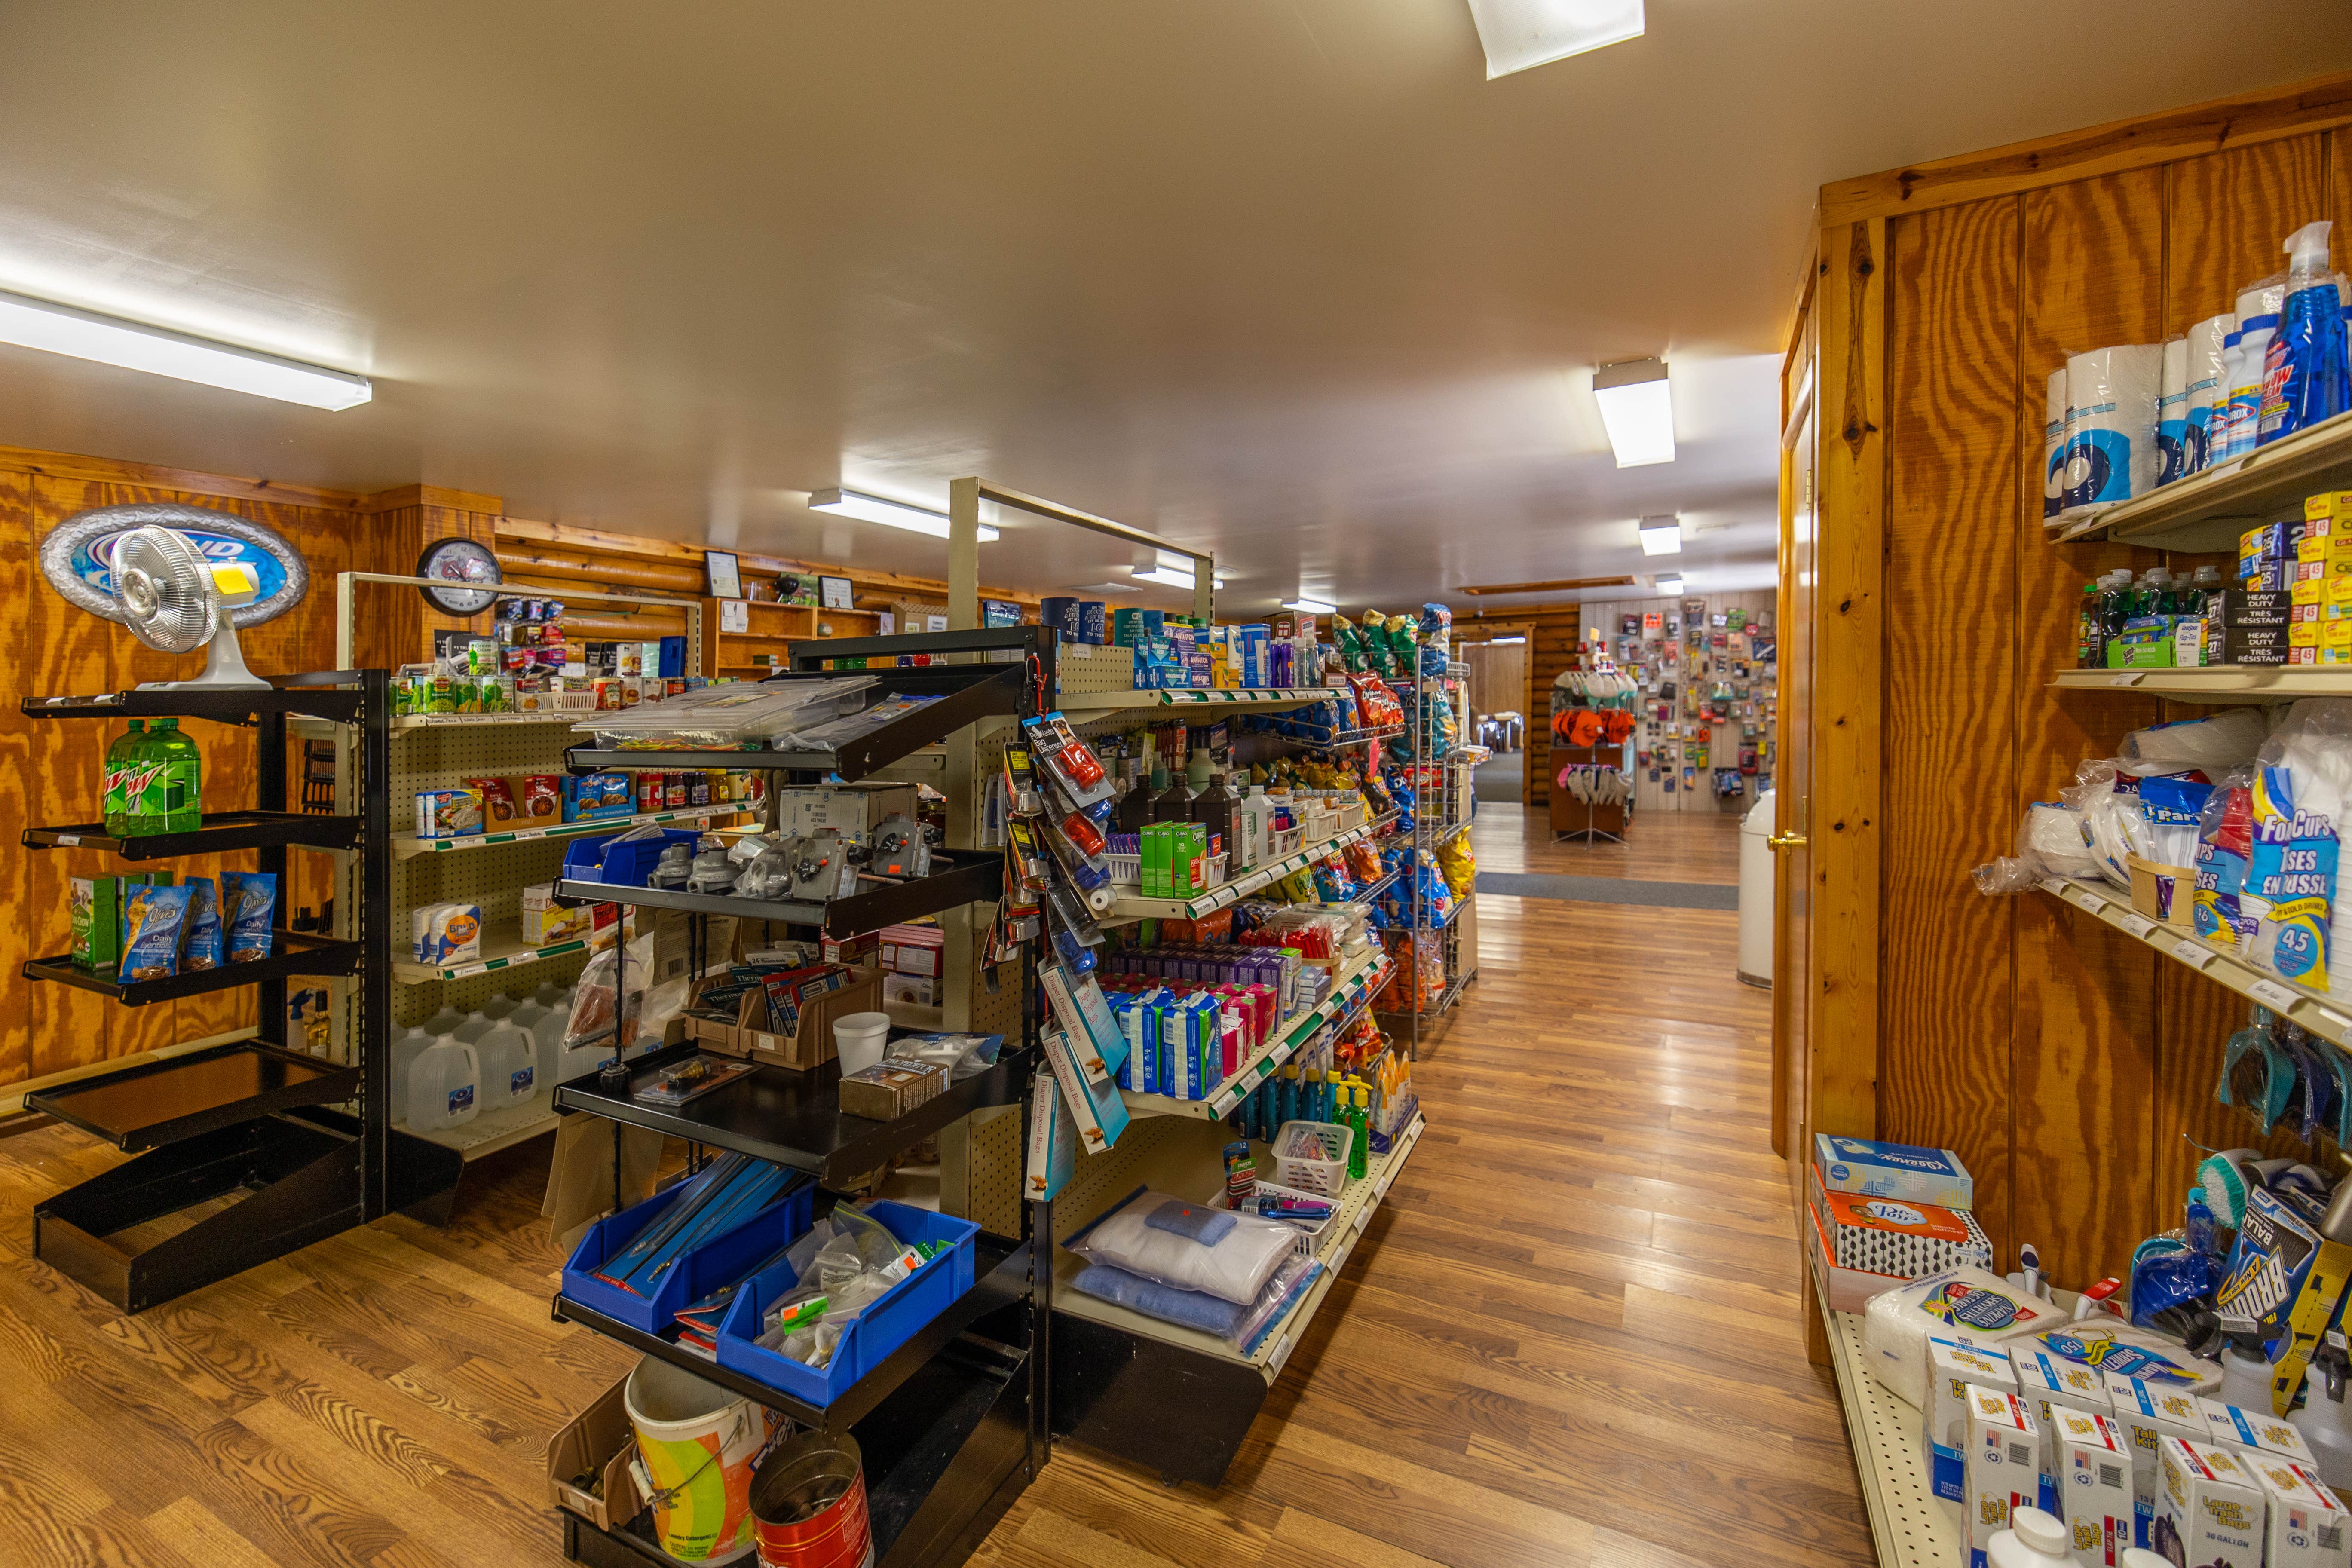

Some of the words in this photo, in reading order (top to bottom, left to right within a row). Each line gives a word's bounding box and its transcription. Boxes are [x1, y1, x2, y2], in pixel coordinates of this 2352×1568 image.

[2318, 521, 2326, 531] 45
[2311, 564, 2320, 574] 45
[2261, 572, 2272, 585] 25
[2208, 606, 2217, 618] 27
[2306, 606, 2315, 618] 45
[1176, 632, 1194, 641] ANTI-ITCH
[2208, 641, 2217, 654] 27
[2303, 648, 2312, 659] 45
[1033, 739, 1047, 747] Bag
[1037, 741, 1063, 753] Dispenser
[2291, 808, 2331, 839] CUPS
[1192, 831, 1205, 841] CURAD
[2197, 907, 2209, 922] 16
[153, 935, 173, 943] Daily
[2281, 928, 2310, 954] 45
[1047, 974, 1061, 997] Diaper
[1058, 997, 1075, 1026] Disposal
[1071, 1024, 1083, 1042] Bags
[1087, 1012, 1099, 1026] Bags
[1050, 1040, 1063, 1066] Diaper
[1059, 1064, 1076, 1095] Disposal
[1071, 1093, 1082, 1111] Bags
[1039, 1079, 1048, 1105] Diaper
[1037, 1105, 1046, 1136] Disposal
[1034, 1135, 1043, 1155] Bags
[1880, 1153, 1950, 1171] Kleenex
[1875, 1204, 1919, 1221] Puffs
[2243, 1210, 2274, 1246] BALAI
[1959, 1295, 2003, 1320] SERVIETTES
[1977, 1302, 2014, 1328] NAPKINS
[2061, 1339, 2083, 1355] 150
[2131, 1425, 2157, 1440] Tall
[839, 1501, 847, 1511] For
[1980, 1499, 1990, 1525] Large
[1998, 1498, 2009, 1522] Bags
[2203, 1495, 2241, 1513] Large
[2209, 1504, 2243, 1520] Trash
[1988, 1501, 1999, 1525] Trash
[2217, 1516, 2251, 1530] Bags
[2073, 1524, 2084, 1550] Large
[2083, 1525, 2093, 1549] Trash
[2091, 1522, 2102, 1547] Bags
[2217, 1534, 2249, 1548] GALLON
